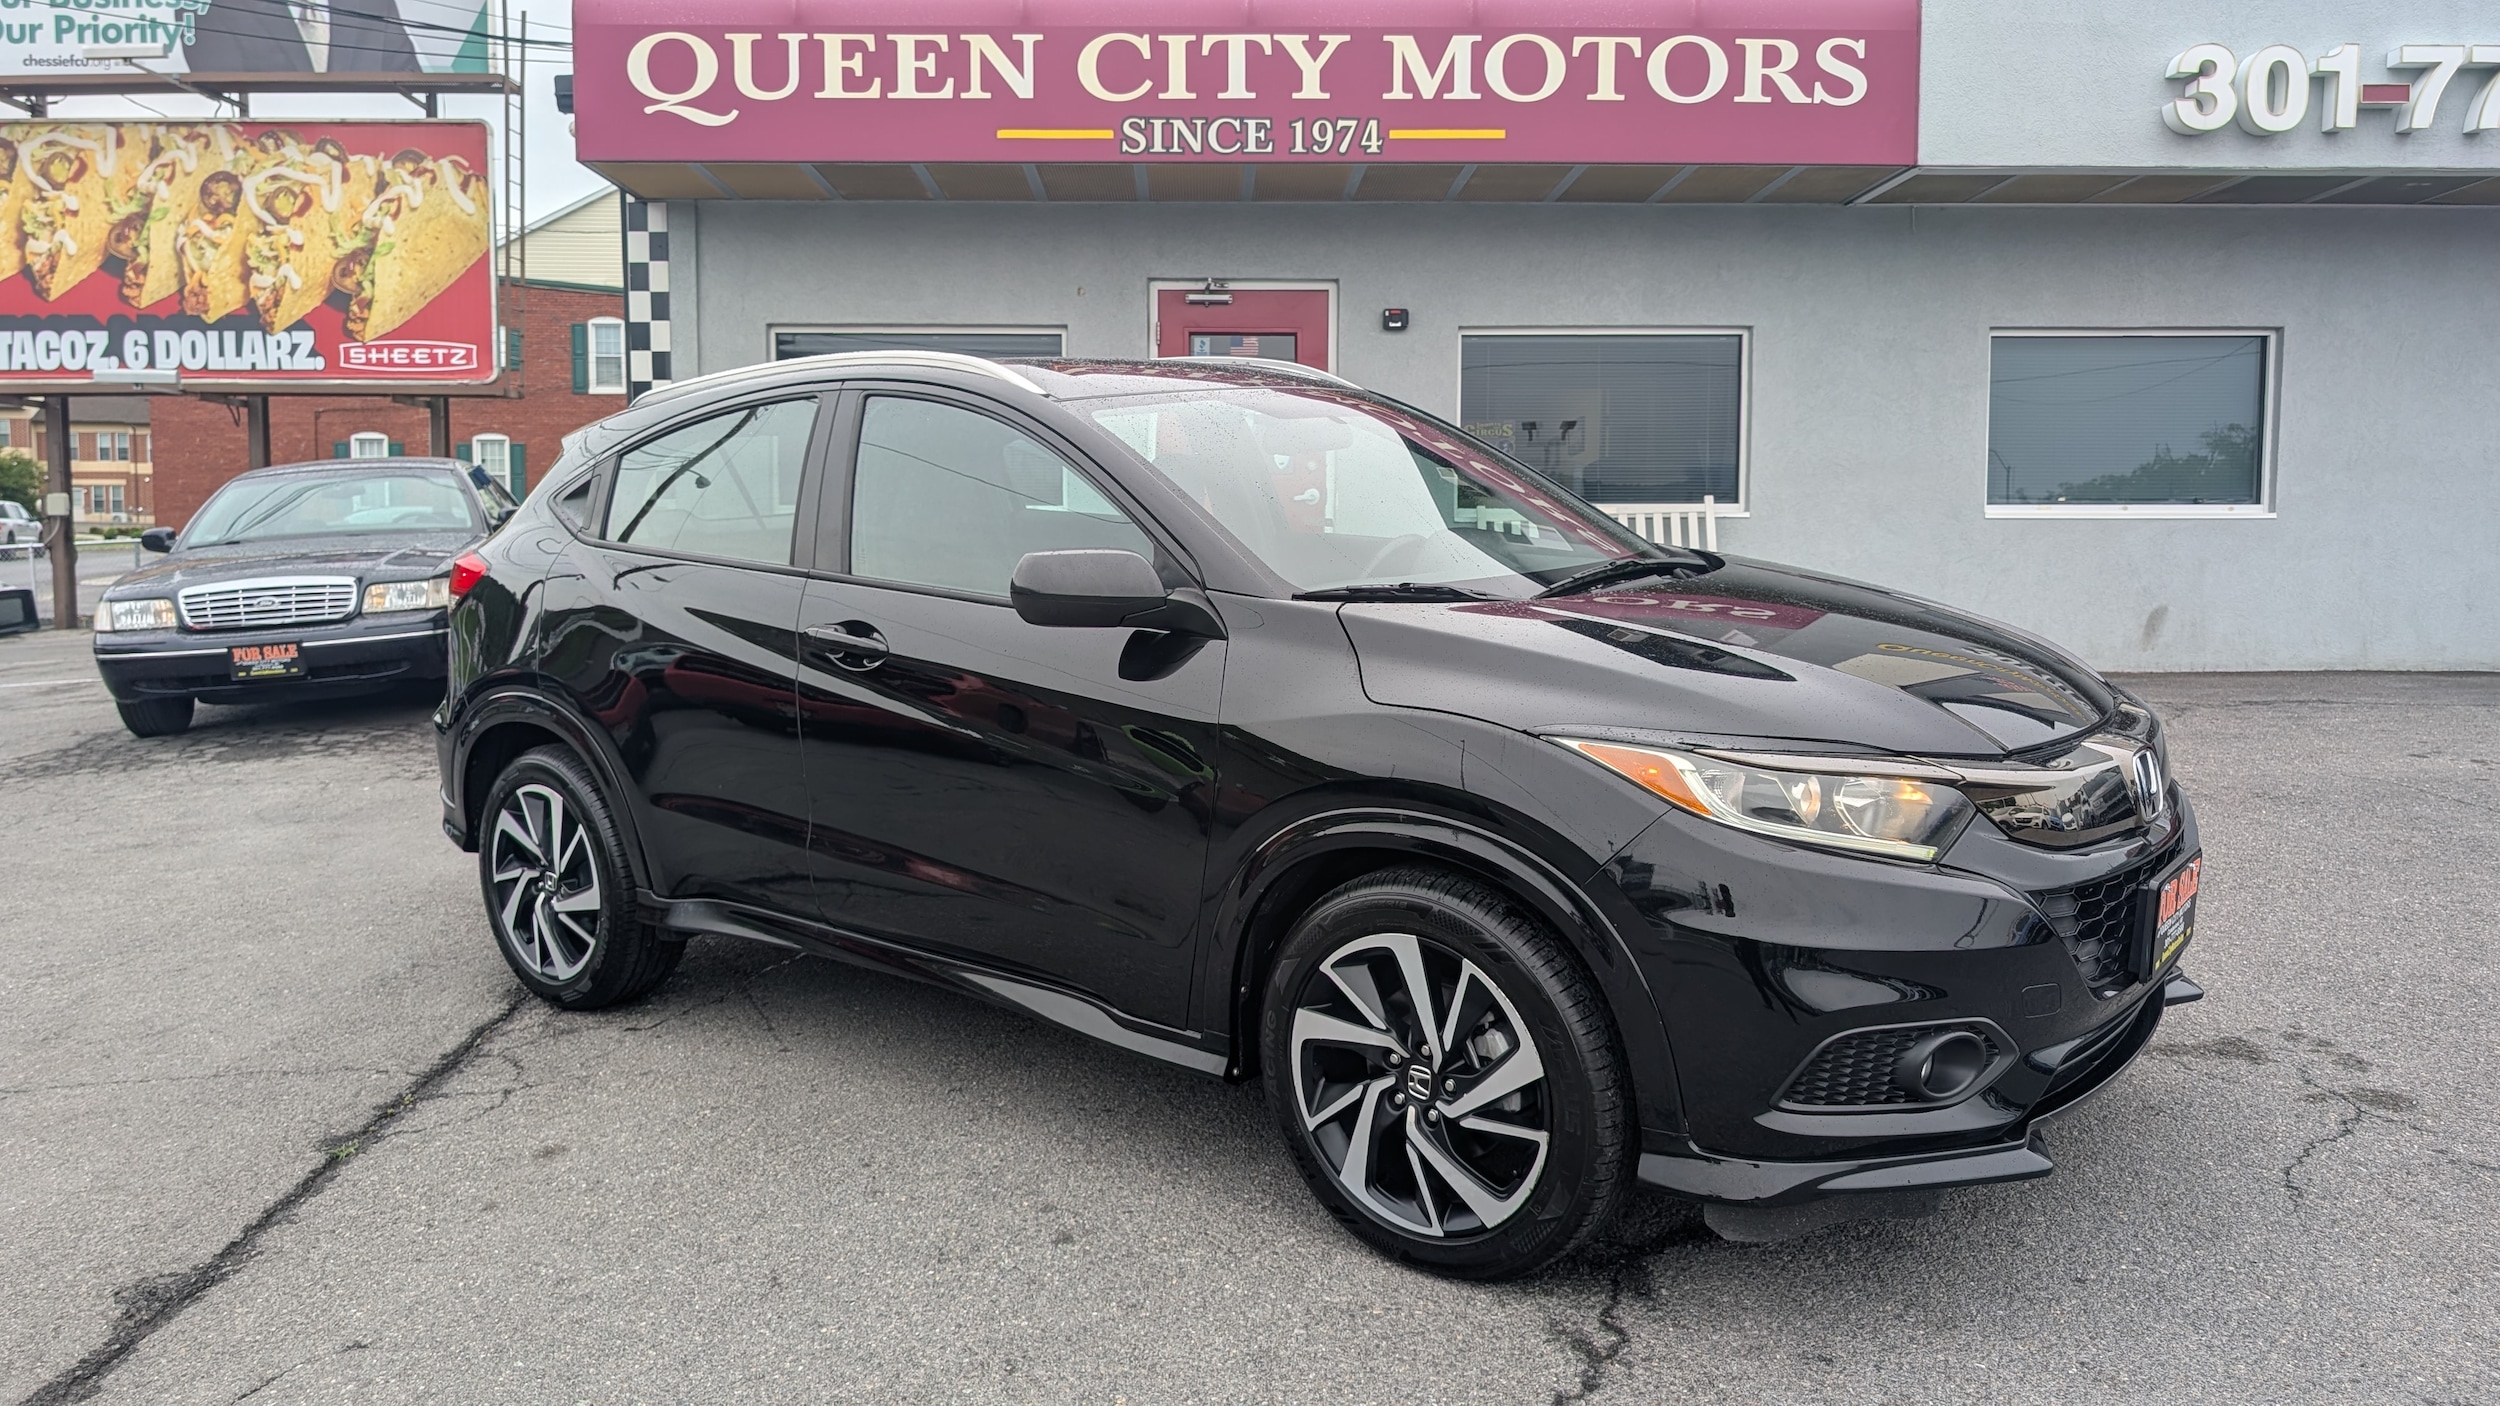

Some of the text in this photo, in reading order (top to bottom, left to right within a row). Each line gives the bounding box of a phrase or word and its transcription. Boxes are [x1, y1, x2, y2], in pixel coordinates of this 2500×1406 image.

[0, 12, 196, 53] ur Priority!
[626, 31, 1868, 127] QUEEN CITY MOTORS
[1119, 116, 1384, 155] SINCE 1974
[123, 330, 149, 371] 6
[153, 330, 326, 371] DOLLARZ.
[349, 347, 467, 365] SHEETZ
[1463, 424, 1514, 437] CIRCUS
[232, 647, 261, 662] FOR
[263, 644, 298, 660] SALE
